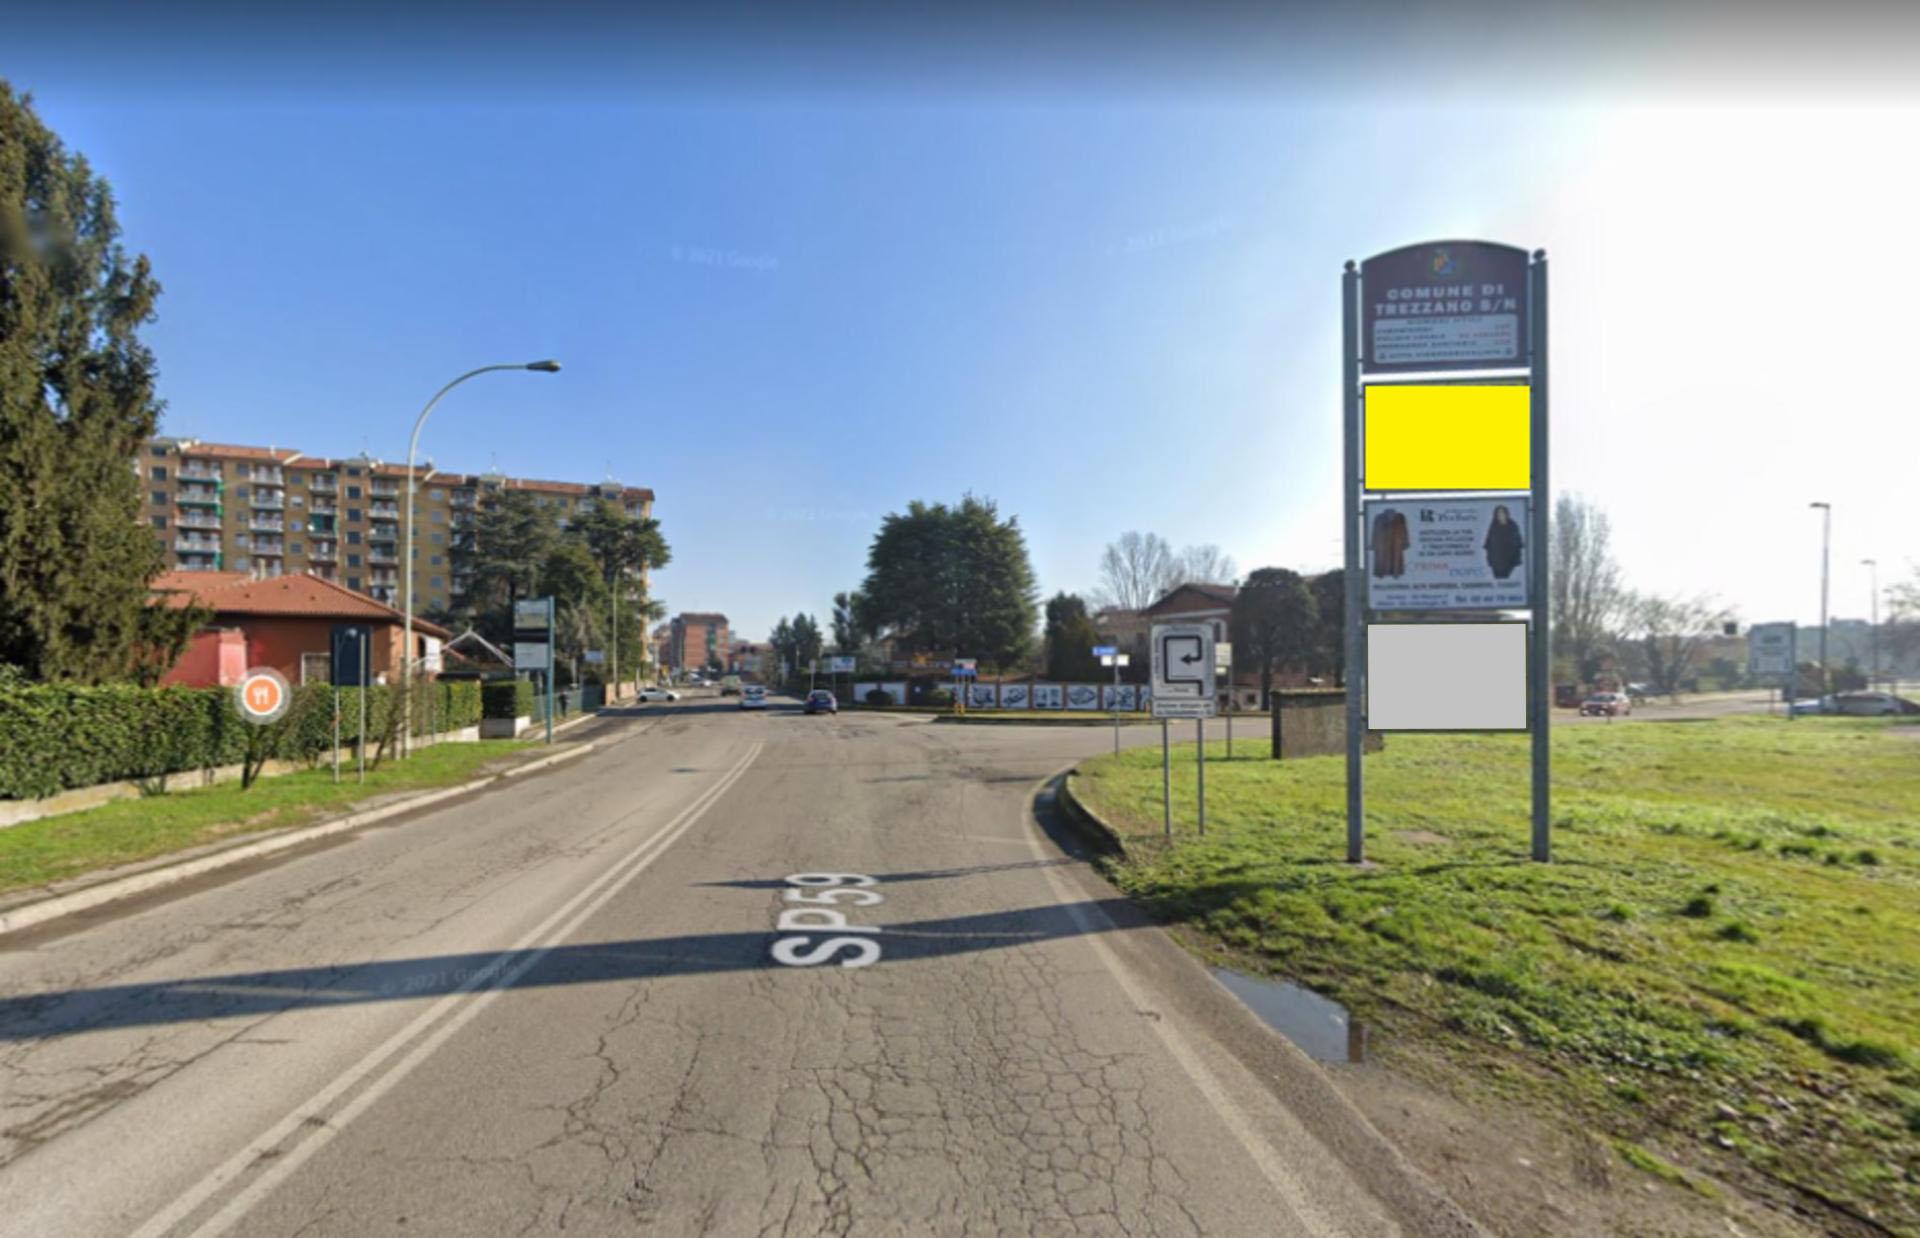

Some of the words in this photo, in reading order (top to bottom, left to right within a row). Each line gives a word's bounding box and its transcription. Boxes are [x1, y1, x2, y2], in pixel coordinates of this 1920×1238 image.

[1386, 284, 1474, 300] COMUNE
[1481, 283, 1505, 296] DI
[1375, 300, 1473, 316] TREZZANO
[1479, 298, 1517, 312] S/N
[772, 872, 884, 967] SP59
